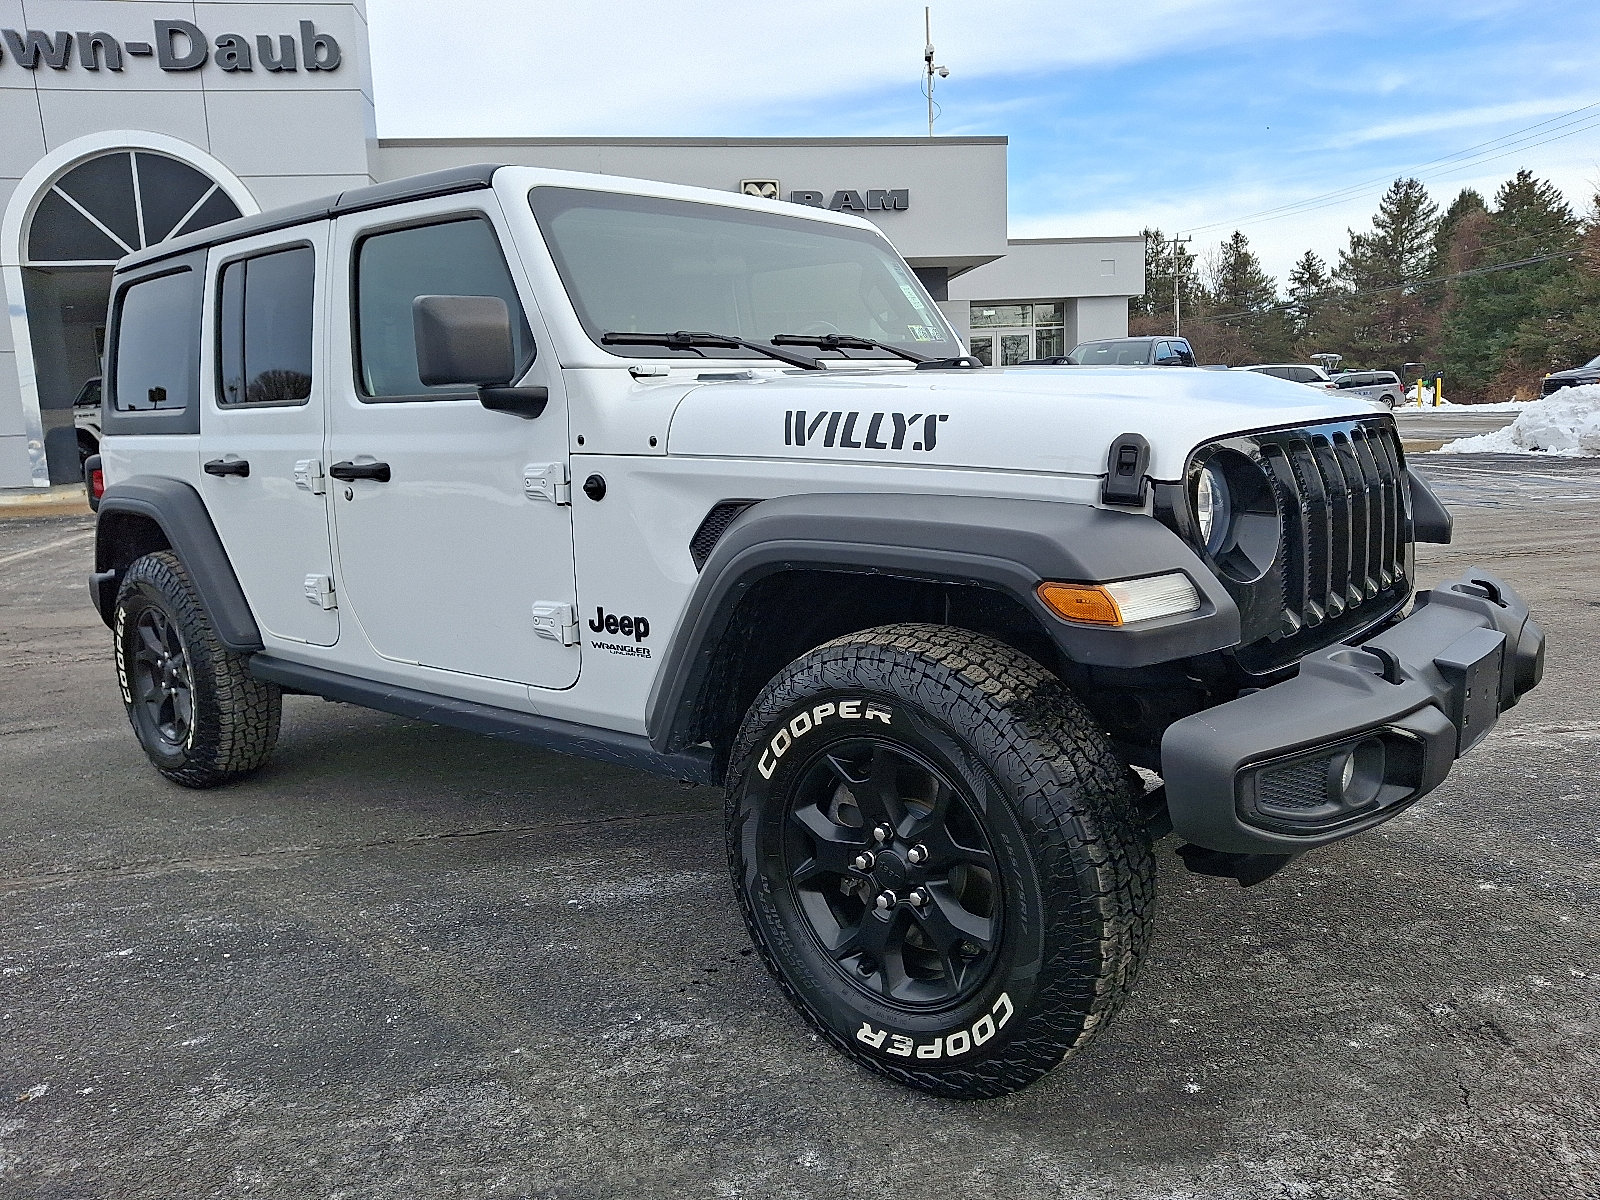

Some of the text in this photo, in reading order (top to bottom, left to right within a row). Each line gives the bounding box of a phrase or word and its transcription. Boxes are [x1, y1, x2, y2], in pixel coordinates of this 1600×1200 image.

[0, 20, 342, 73] wn-Daub
[791, 189, 909, 212] RAM
[784, 410, 950, 451] WILLYS
[589, 606, 650, 642] Jeep
[116, 606, 132, 704] COOPER
[591, 640, 651, 655] WRANGLER
[609, 649, 652, 659] UNLIMITED
[757, 700, 893, 780] COOPER
[856, 992, 1014, 1060] COOPER
